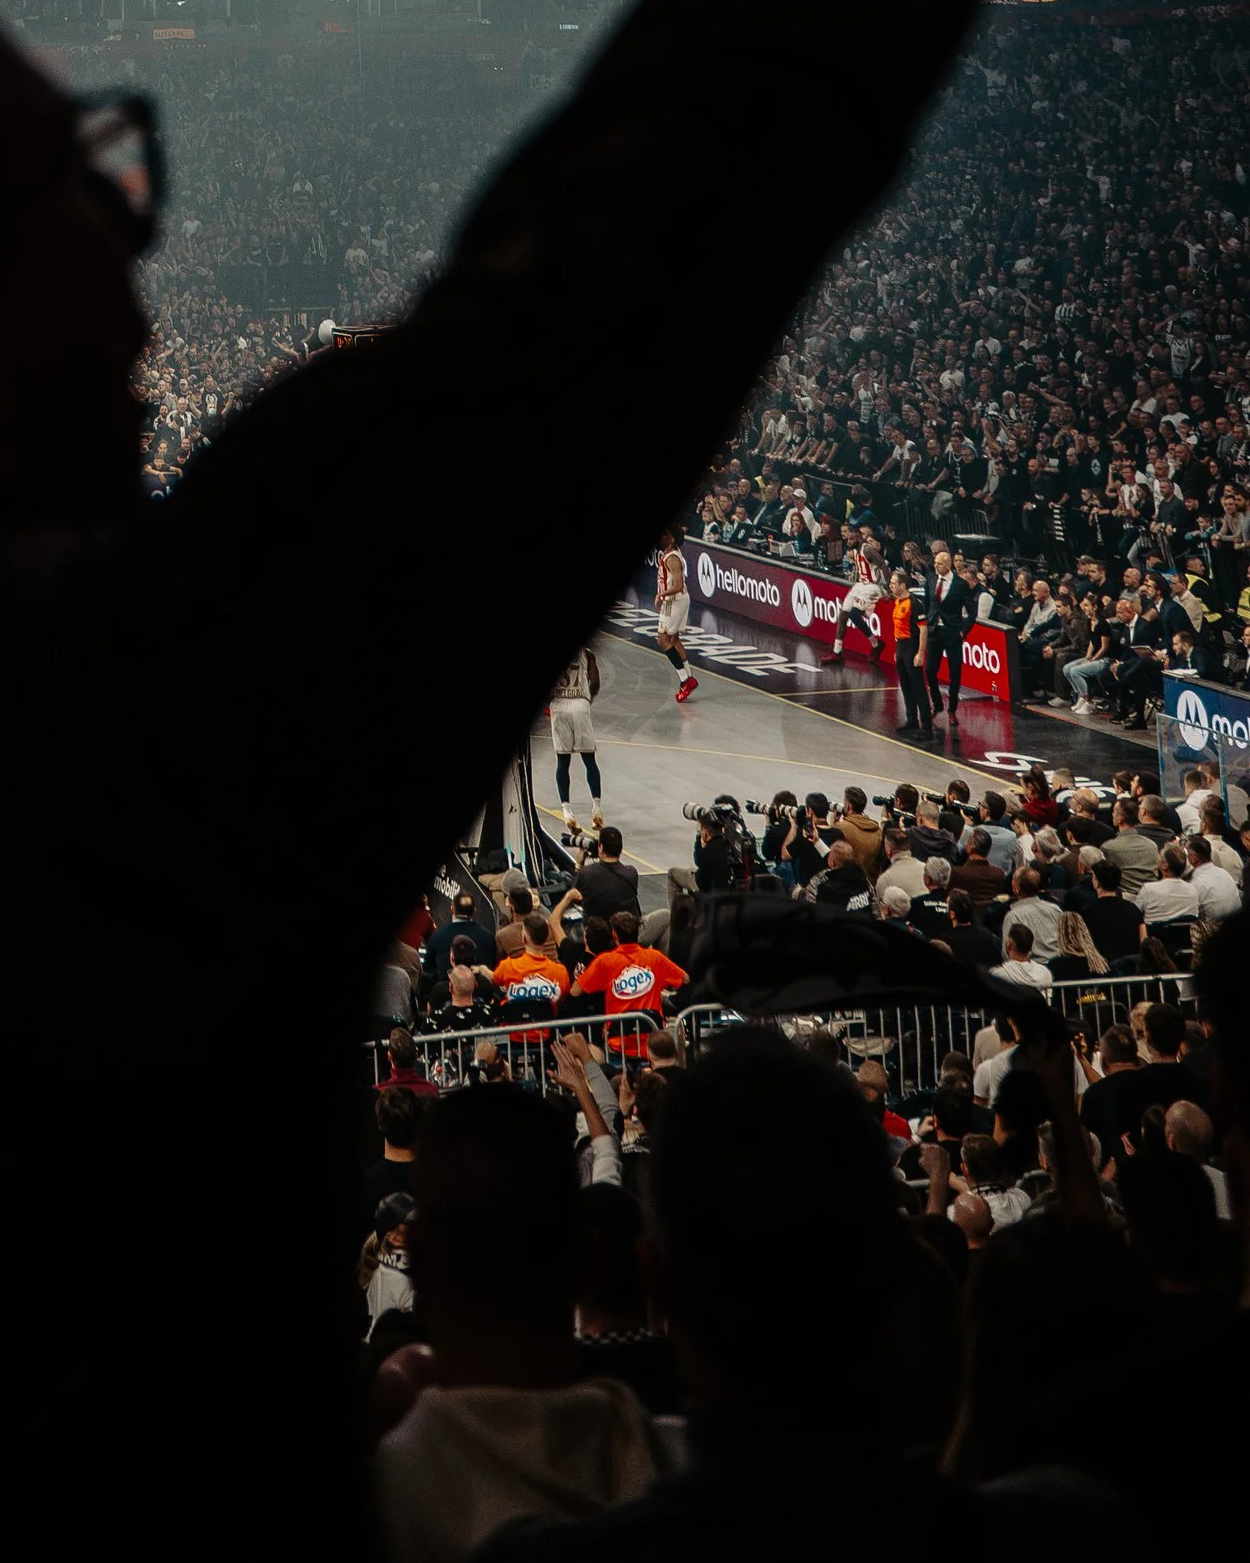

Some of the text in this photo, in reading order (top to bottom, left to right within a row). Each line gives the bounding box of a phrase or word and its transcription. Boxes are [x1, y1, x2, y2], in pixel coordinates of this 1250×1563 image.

[715, 563, 781, 608] hellomoto
[1211, 713, 1250, 750] mo
[612, 969, 653, 995] Logex
